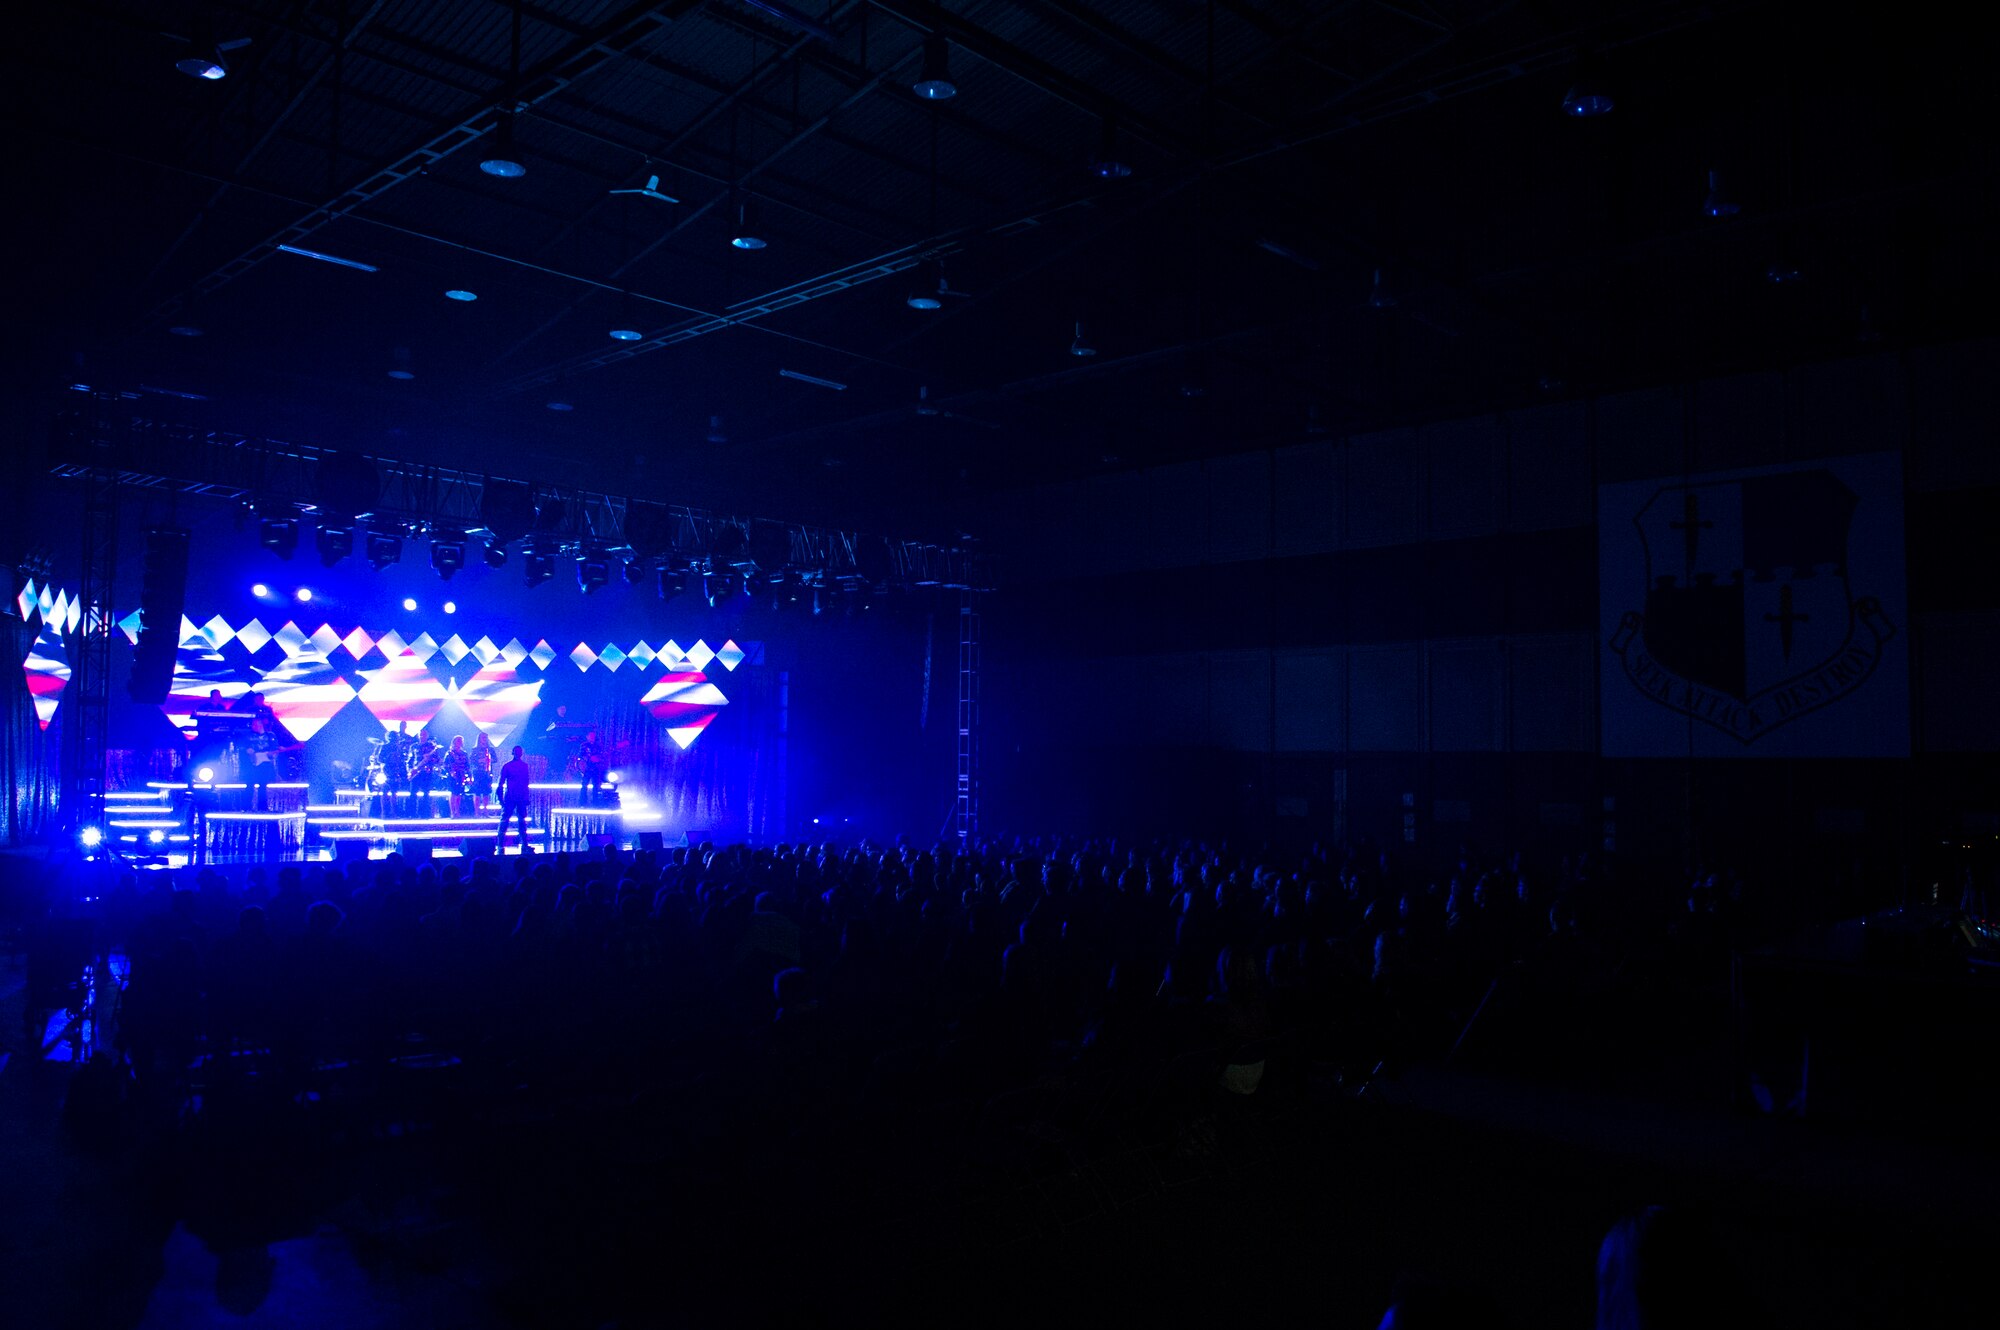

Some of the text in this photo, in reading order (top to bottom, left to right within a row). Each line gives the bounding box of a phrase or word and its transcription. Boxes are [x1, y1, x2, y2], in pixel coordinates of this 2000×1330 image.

[1632, 641, 1873, 732] SEEK ATTACK DESTROY
